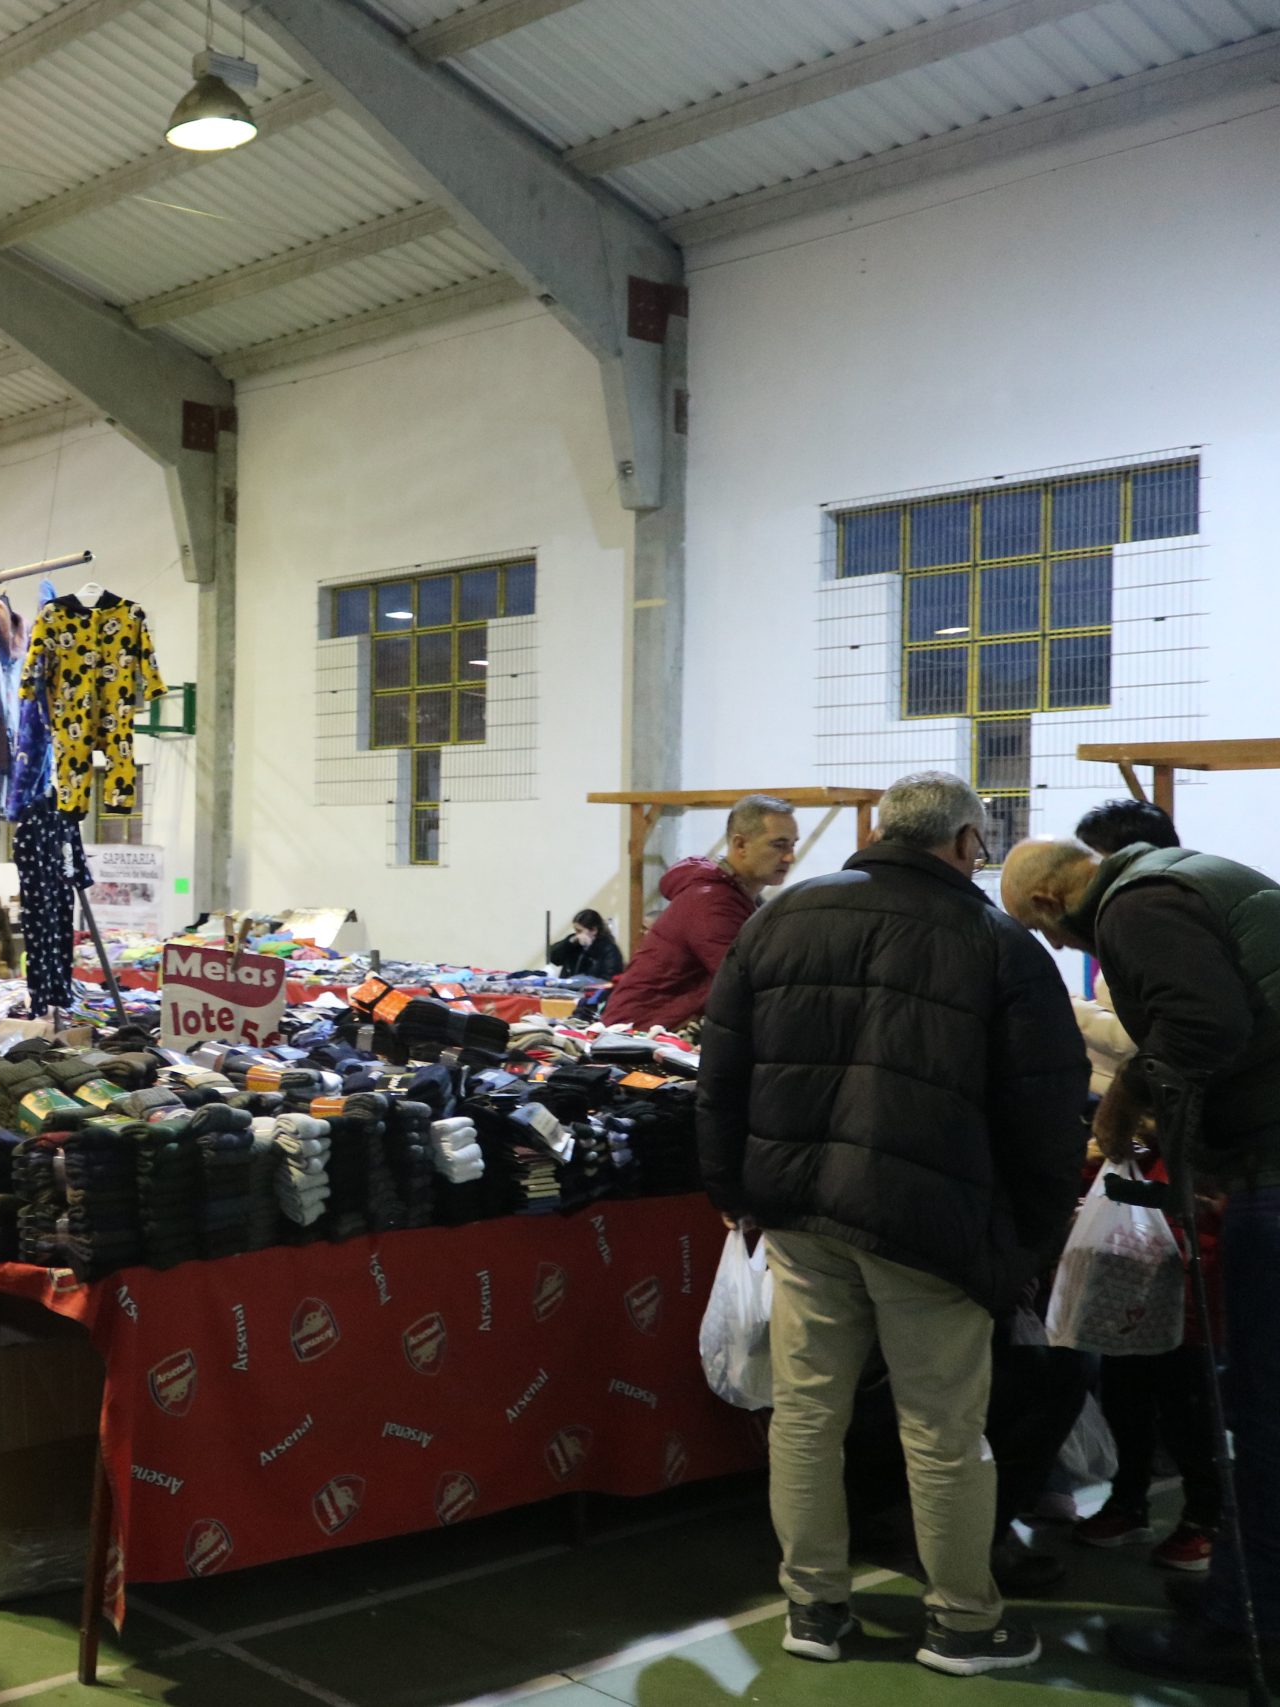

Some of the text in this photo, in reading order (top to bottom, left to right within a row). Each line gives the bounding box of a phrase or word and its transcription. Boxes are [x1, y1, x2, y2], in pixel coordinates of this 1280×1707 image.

[102, 852, 157, 865] SAPATARIA
[166, 949, 276, 987] Meias
[170, 1001, 235, 1036] lote
[679, 1234, 691, 1296] Arsenal
[476, 1269, 492, 1333] Arsenal
[231, 1303, 249, 1373] Arsenal
[156, 1357, 193, 1385] Arsenal
[504, 1367, 550, 1425] Arsenal
[258, 1413, 316, 1468] Arsenal
[380, 1421, 435, 1449] Arsenal
